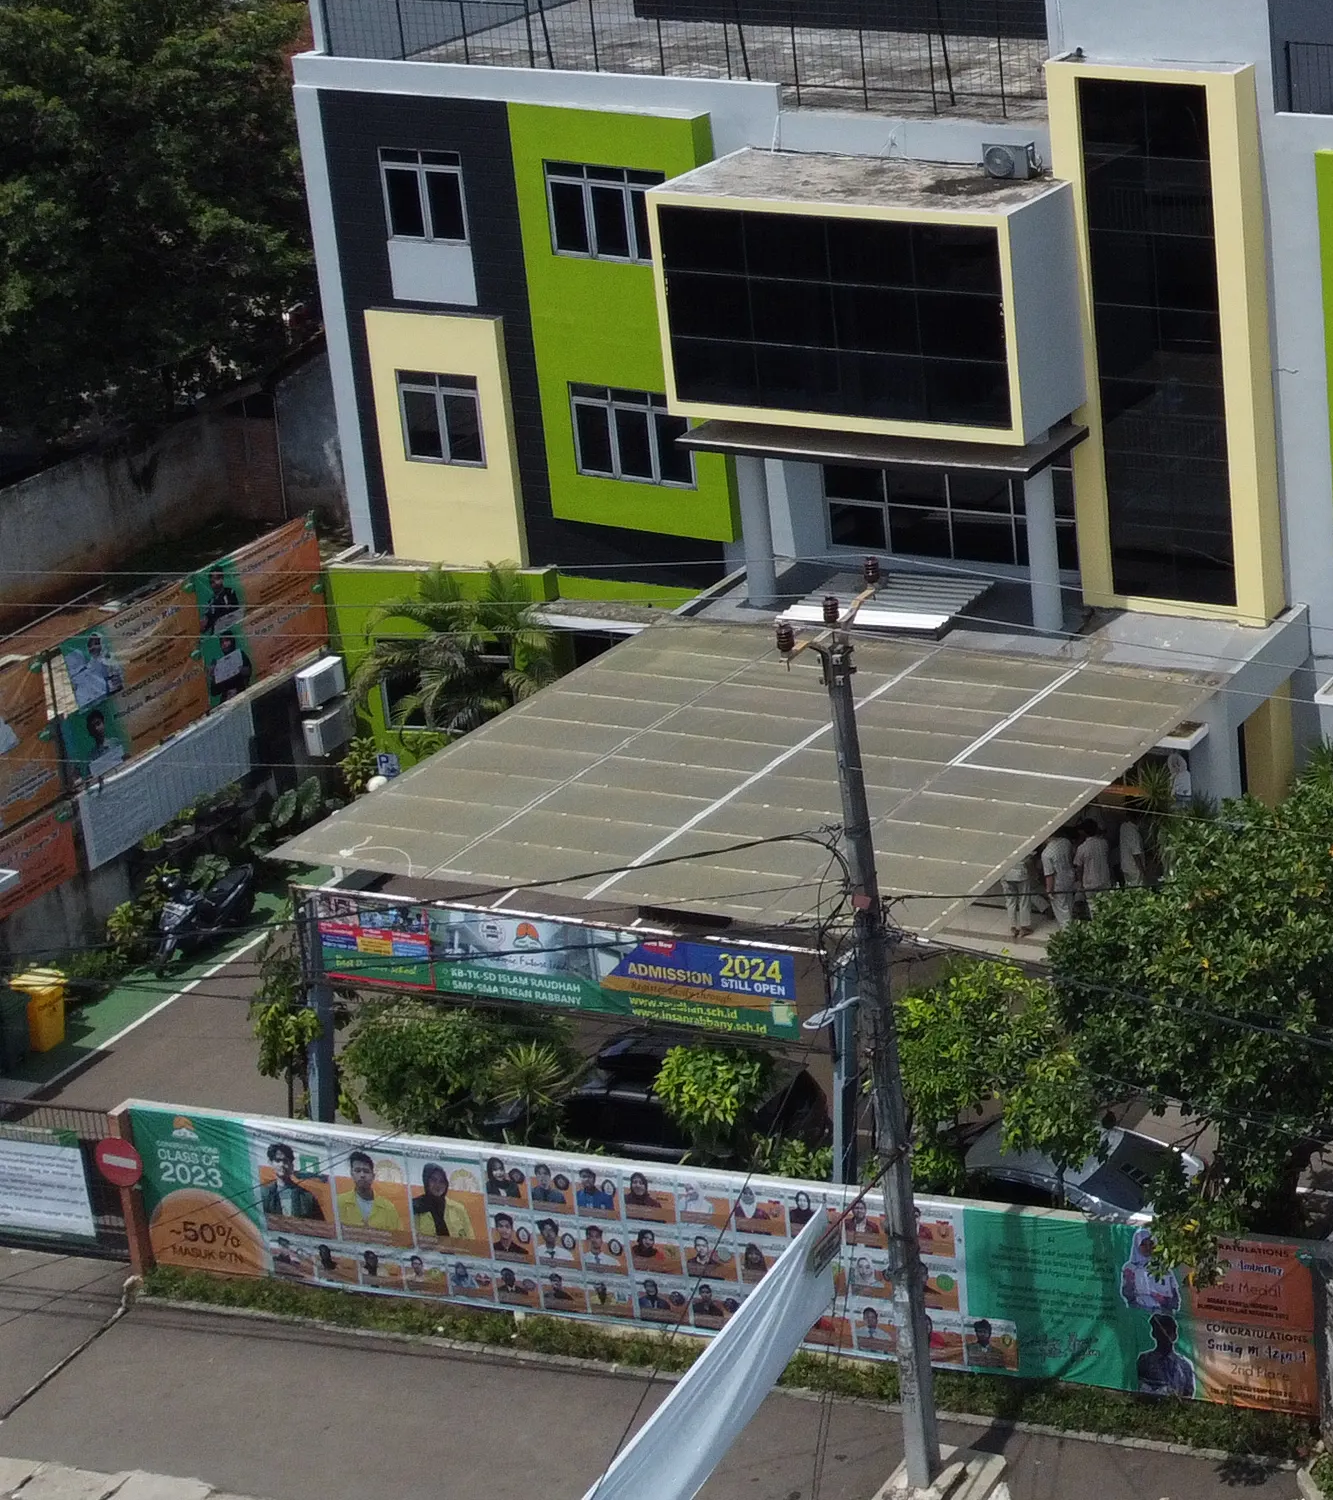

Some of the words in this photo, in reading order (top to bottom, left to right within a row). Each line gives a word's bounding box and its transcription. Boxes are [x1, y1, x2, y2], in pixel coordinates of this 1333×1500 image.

[379, 754, 389, 769] P
[628, 962, 713, 986] ADMISSION
[719, 953, 782, 983] 2024
[451, 968, 496, 982] KB-TK-SD
[498, 974, 528, 987] ISLAM
[531, 978, 581, 993] RAUDHAH
[721, 978, 752, 992] STILL
[753, 982, 786, 996] OPEN
[452, 980, 499, 995] SMP-SMA
[500, 986, 532, 999] INSAN
[535, 990, 582, 1005] RABBANY
[157, 1148, 200, 1164] CLASS
[202, 1153, 220, 1167] OF
[159, 1162, 223, 1188] 2023
[172, 1245, 216, 1260] MASUK
[219, 1251, 244, 1264] PTN
[1206, 1323, 1309, 1344] CONGRATULATIONS
[1230, 1362, 1254, 1377] 2nd
